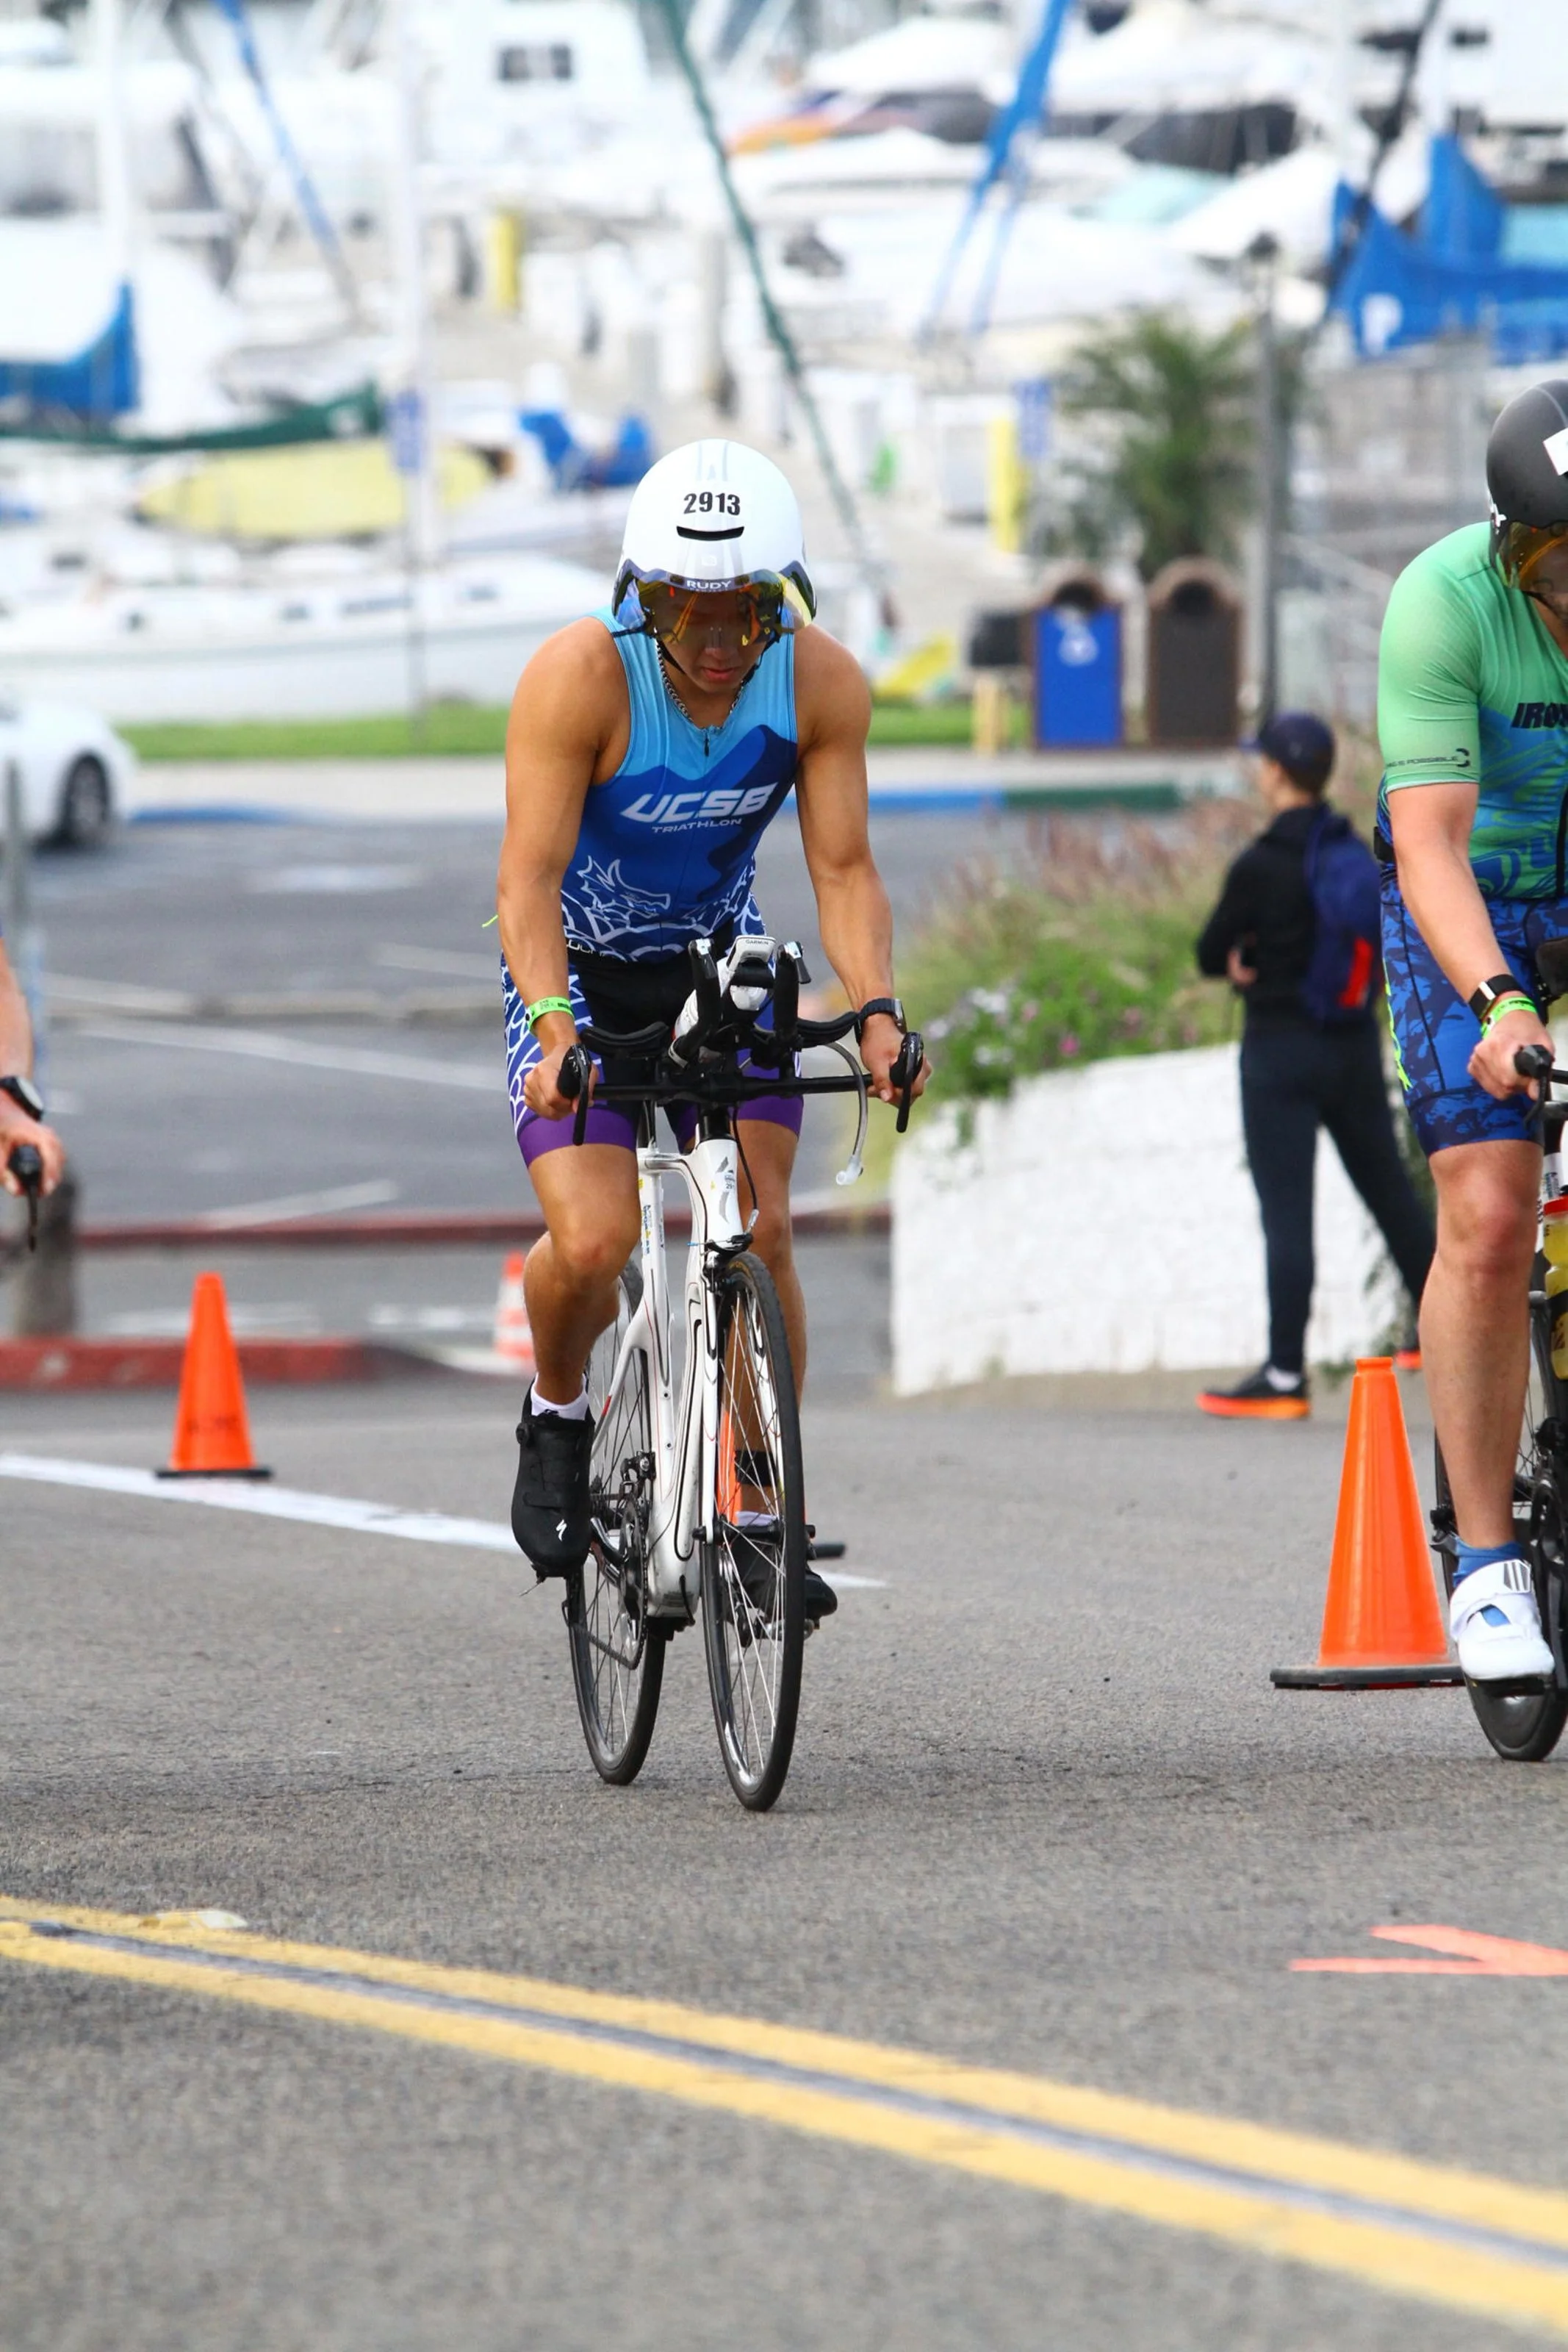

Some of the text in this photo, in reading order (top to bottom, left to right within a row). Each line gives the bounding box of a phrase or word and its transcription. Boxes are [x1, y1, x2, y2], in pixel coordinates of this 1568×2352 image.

[683, 492, 741, 516] 2913
[686, 579, 732, 590] RUDY
[619, 782, 779, 824] UCSB
[651, 818, 742, 834] TRIATHLON
